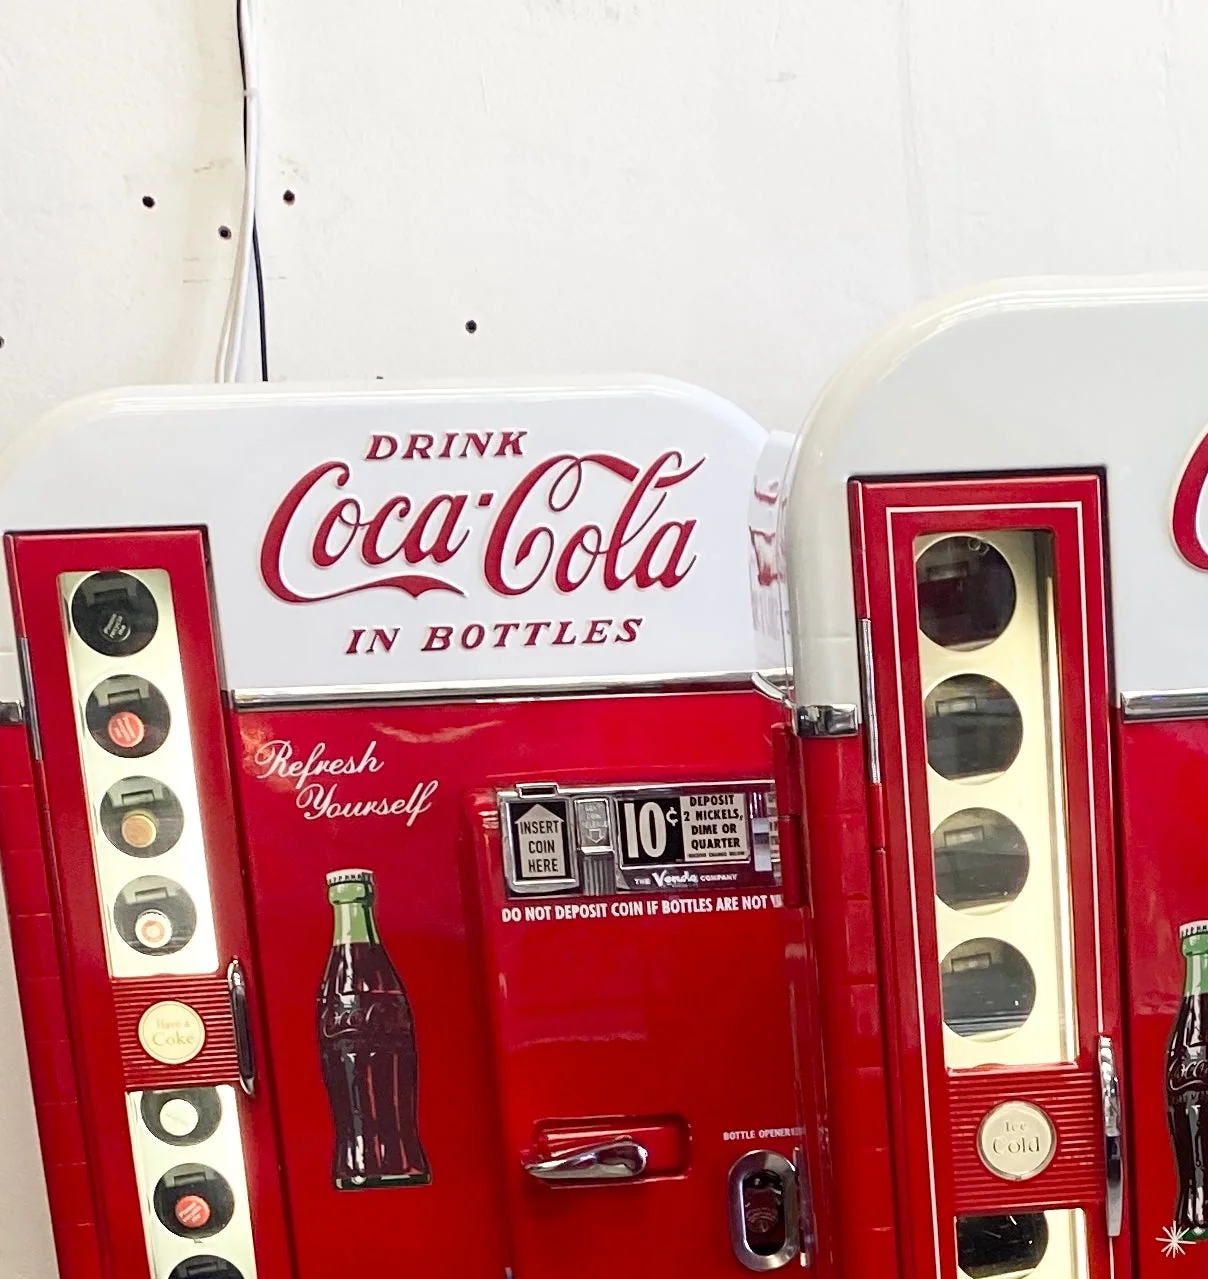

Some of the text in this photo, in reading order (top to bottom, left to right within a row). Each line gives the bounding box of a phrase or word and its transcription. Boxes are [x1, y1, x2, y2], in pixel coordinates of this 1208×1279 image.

[365, 431, 528, 461] DRINK
[260, 450, 706, 603] Coca-Cola
[345, 618, 643, 656] IN BOTTLES
[254, 740, 384, 789] Refresh
[296, 780, 439, 827] Yourself
[689, 795, 735, 806] DEPOSIT
[683, 811, 690, 821] 2
[520, 820, 559, 835] INSERT
[623, 801, 679, 859] 10¢
[691, 824, 737, 835] DIME OR
[528, 839, 555, 854] COIN
[691, 838, 741, 850] QUARTER
[528, 859, 559, 873] HERE
[634, 869, 738, 888] THE Vendo COMPANY
[502, 907, 522, 922] DO
[525, 906, 552, 921] NOT
[555, 903, 608, 920] DEPOSIT
[611, 901, 643, 917] COIN
[646, 900, 659, 915] IF
[661, 898, 713, 914] BOTTLES
[715, 896, 739, 911] ARE
[741, 895, 767, 910] NOT
[152, 1031, 195, 1046] Coke
[1006, 1121, 1026, 1132] Ice
[723, 1128, 791, 1141] BOTTLE OPENER
[993, 1136, 1039, 1154] Cold
